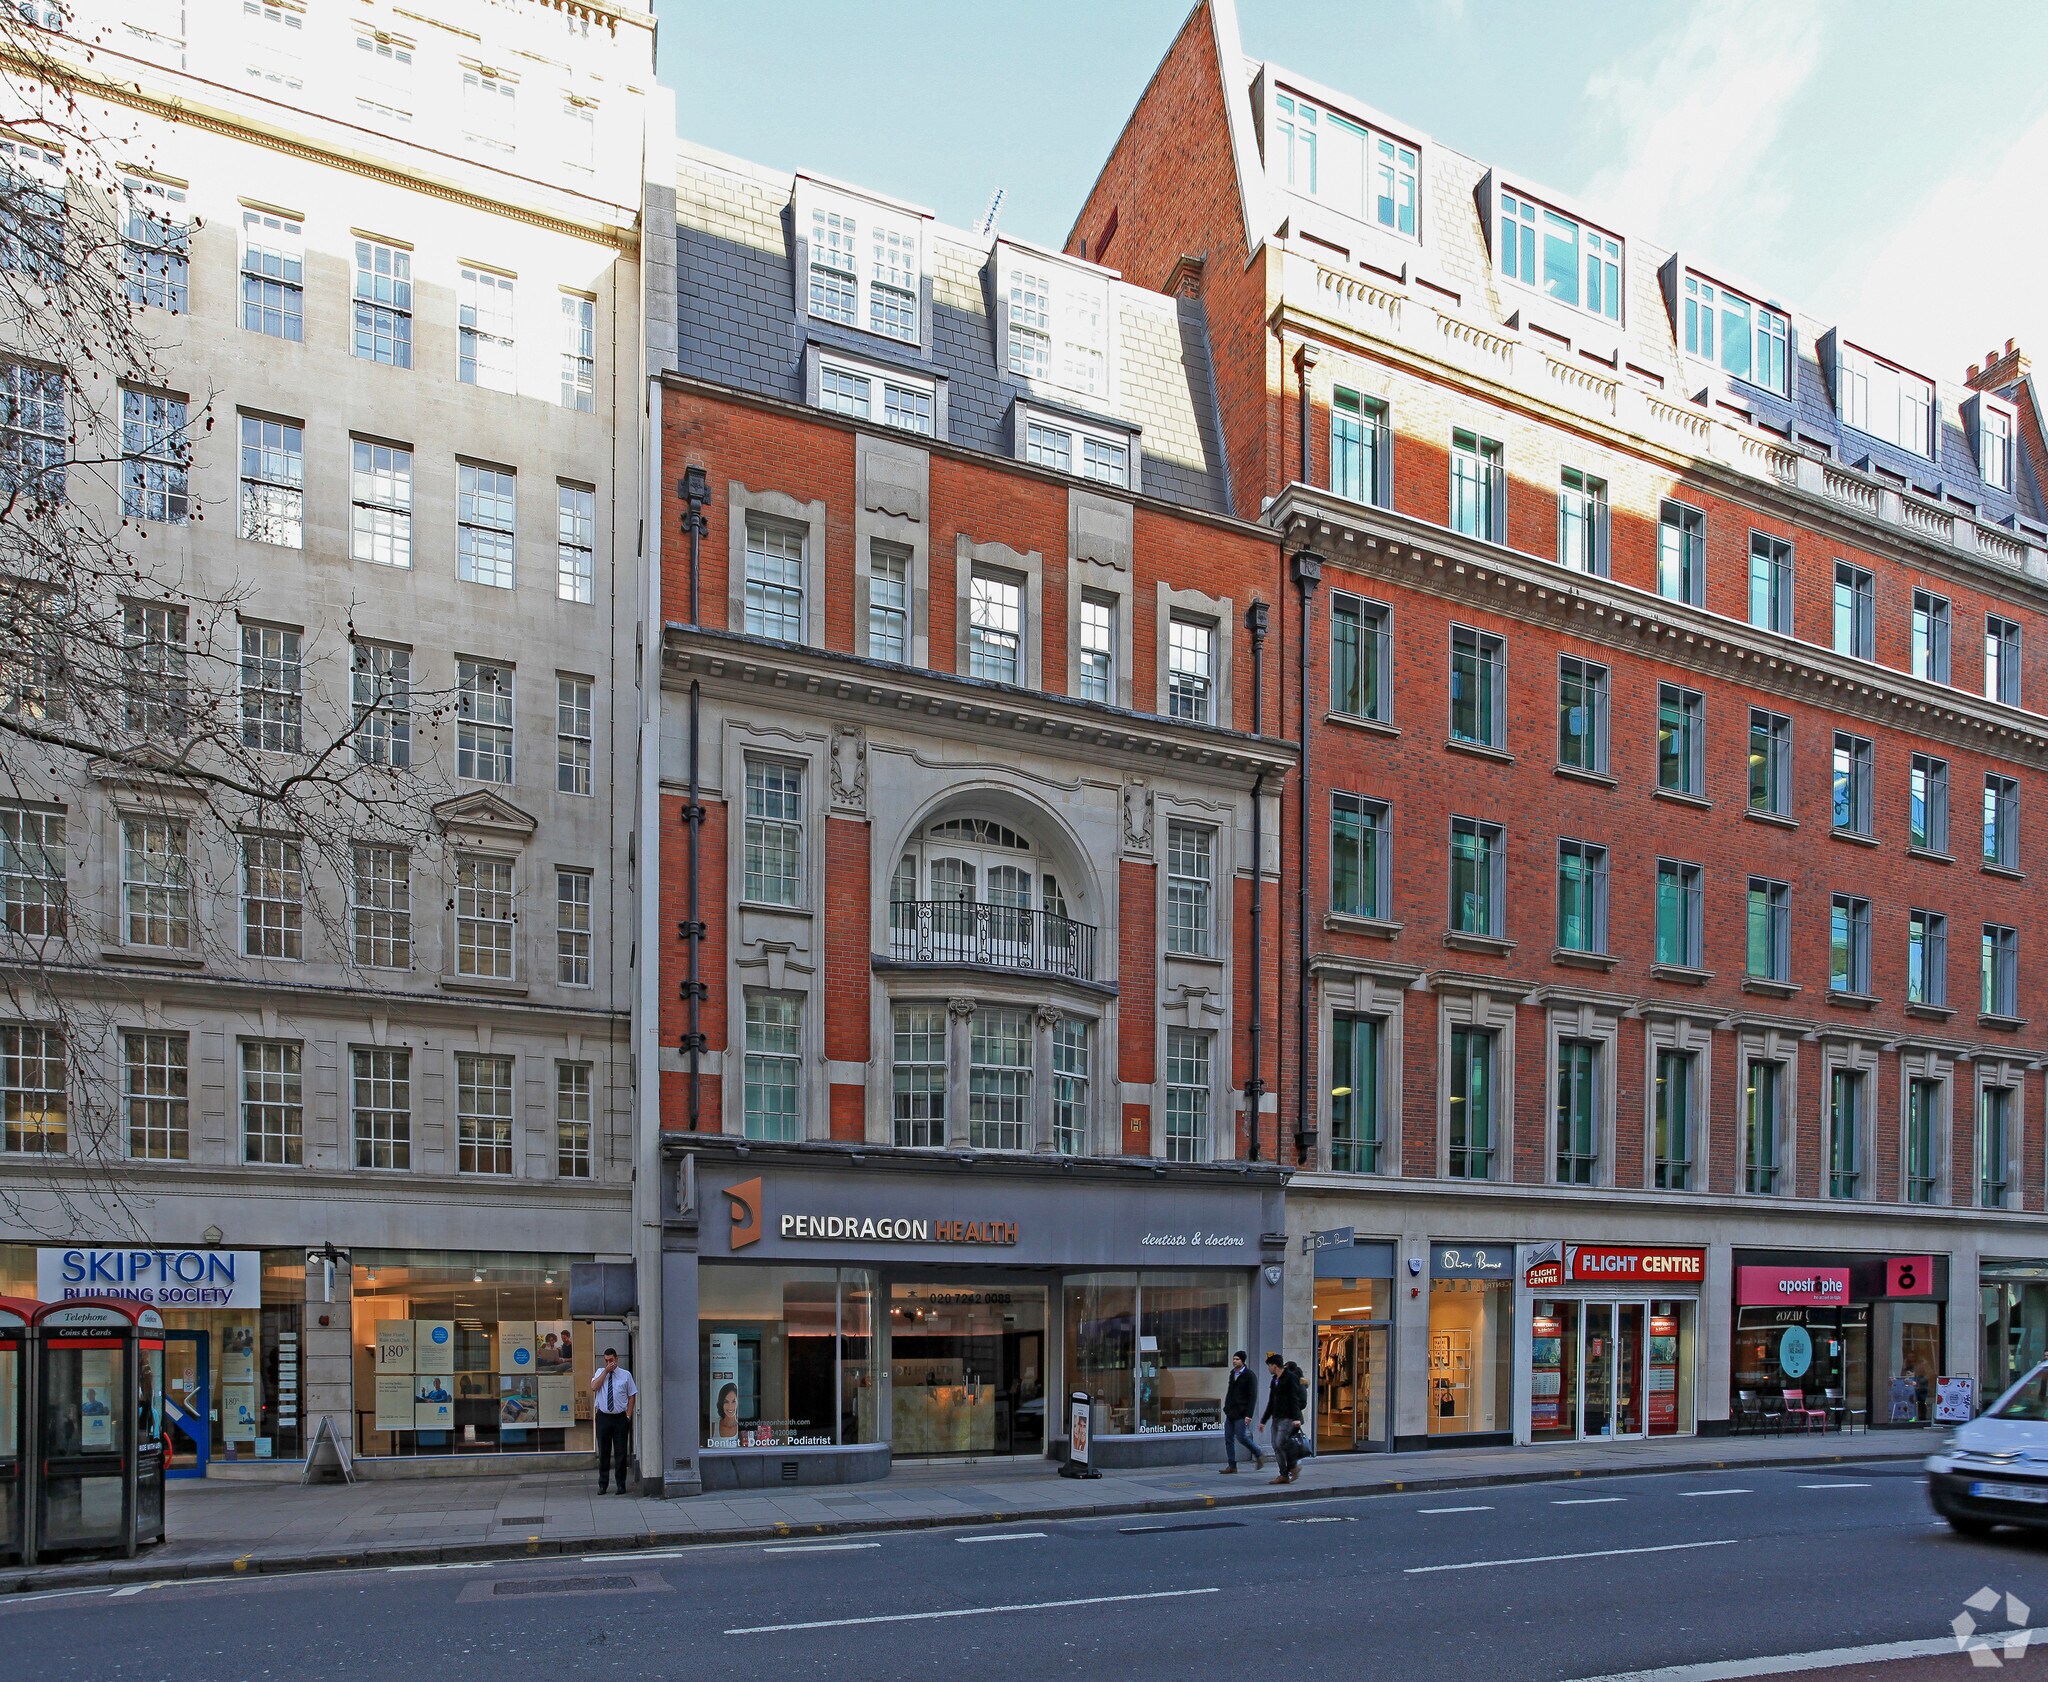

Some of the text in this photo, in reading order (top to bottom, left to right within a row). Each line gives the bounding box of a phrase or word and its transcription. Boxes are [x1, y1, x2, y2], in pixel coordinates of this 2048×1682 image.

[781, 1214, 1020, 1242] PENDRAGON HEALTH
[1141, 1231, 1245, 1246] dentists & doctors
[62, 1250, 235, 1283] SKIPTON
[1582, 1254, 1700, 1273] FLIGHT CENTRE
[1530, 1268, 1557, 1278] FLIGHT
[1529, 1276, 1558, 1285] CENTRE
[930, 1293, 1011, 1304] 020 7242 0088
[64, 1312, 107, 1323] Telephone
[1140, 1425, 1167, 1433] Dentist
[1172, 1424, 1197, 1432] Doctor
[1202, 1422, 1225, 1430] Podiat
[707, 1438, 741, 1448] Dentist
[748, 1437, 780, 1447] Doctor
[787, 1436, 831, 1445] Podiatrist
